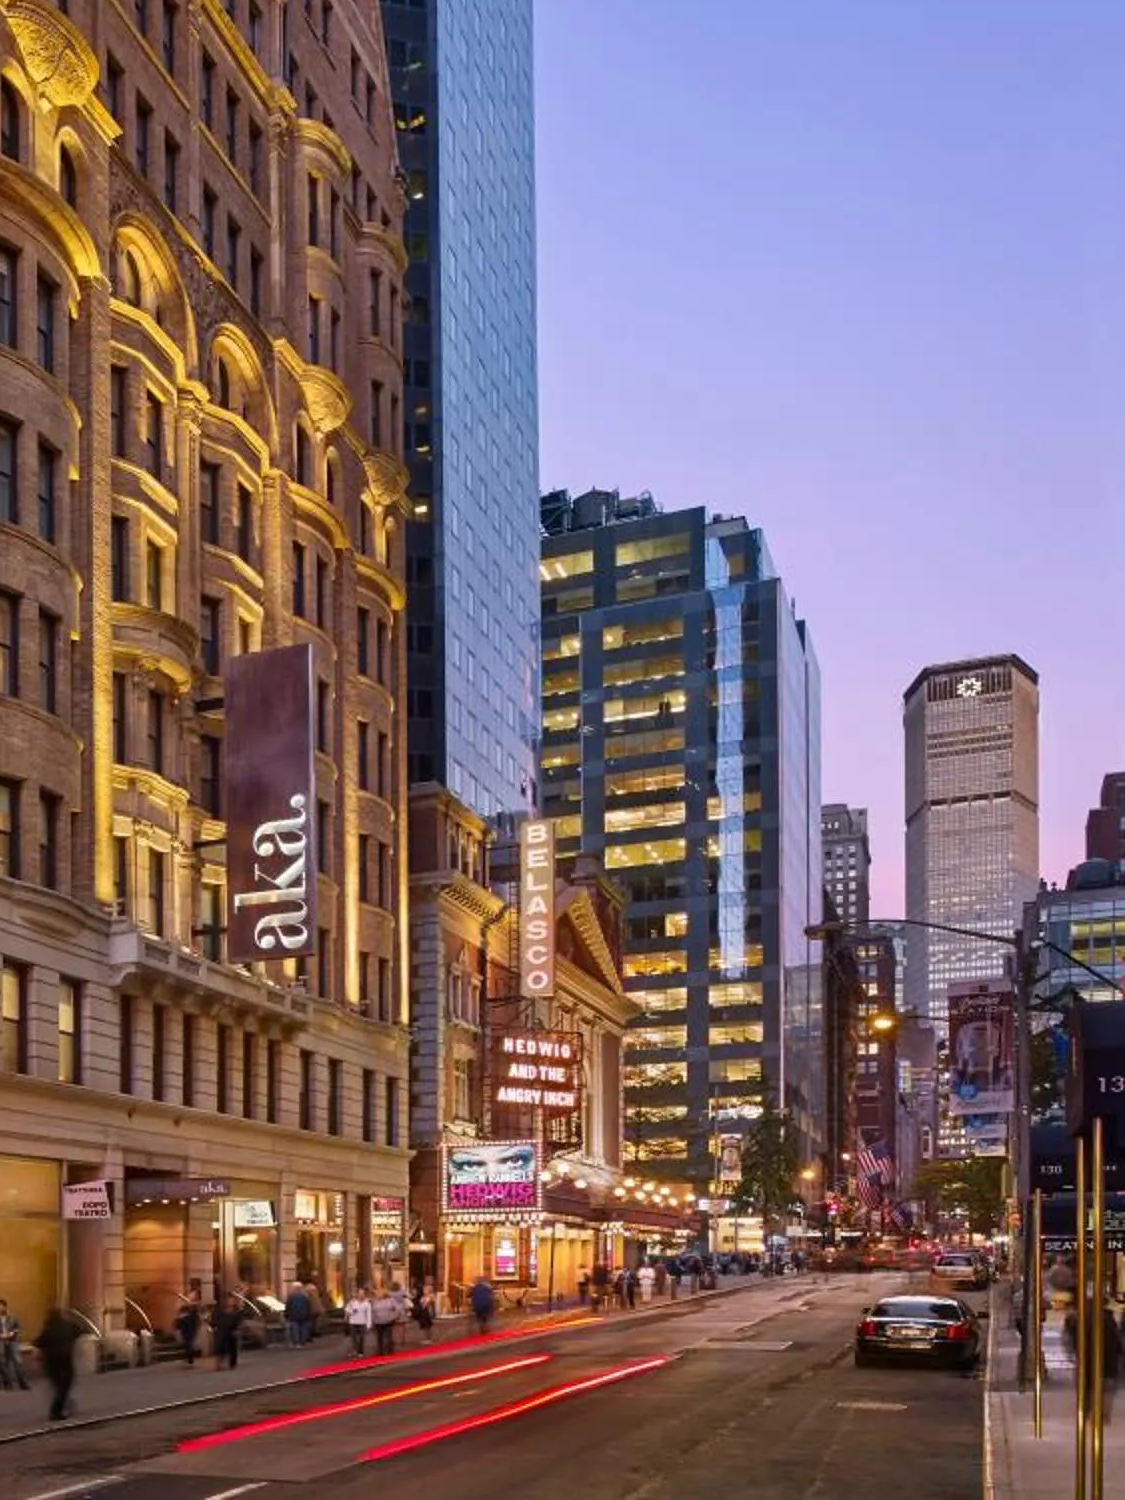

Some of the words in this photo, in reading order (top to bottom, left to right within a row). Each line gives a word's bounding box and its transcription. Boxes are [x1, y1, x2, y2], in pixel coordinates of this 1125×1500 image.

[525, 825, 549, 989] BELASCO
[503, 1037, 572, 1059] HEDWIG
[507, 1063, 537, 1080] AND
[539, 1065, 567, 1082] THE
[497, 1086, 542, 1105] ANGRY
[543, 1090, 575, 1107] INCH
